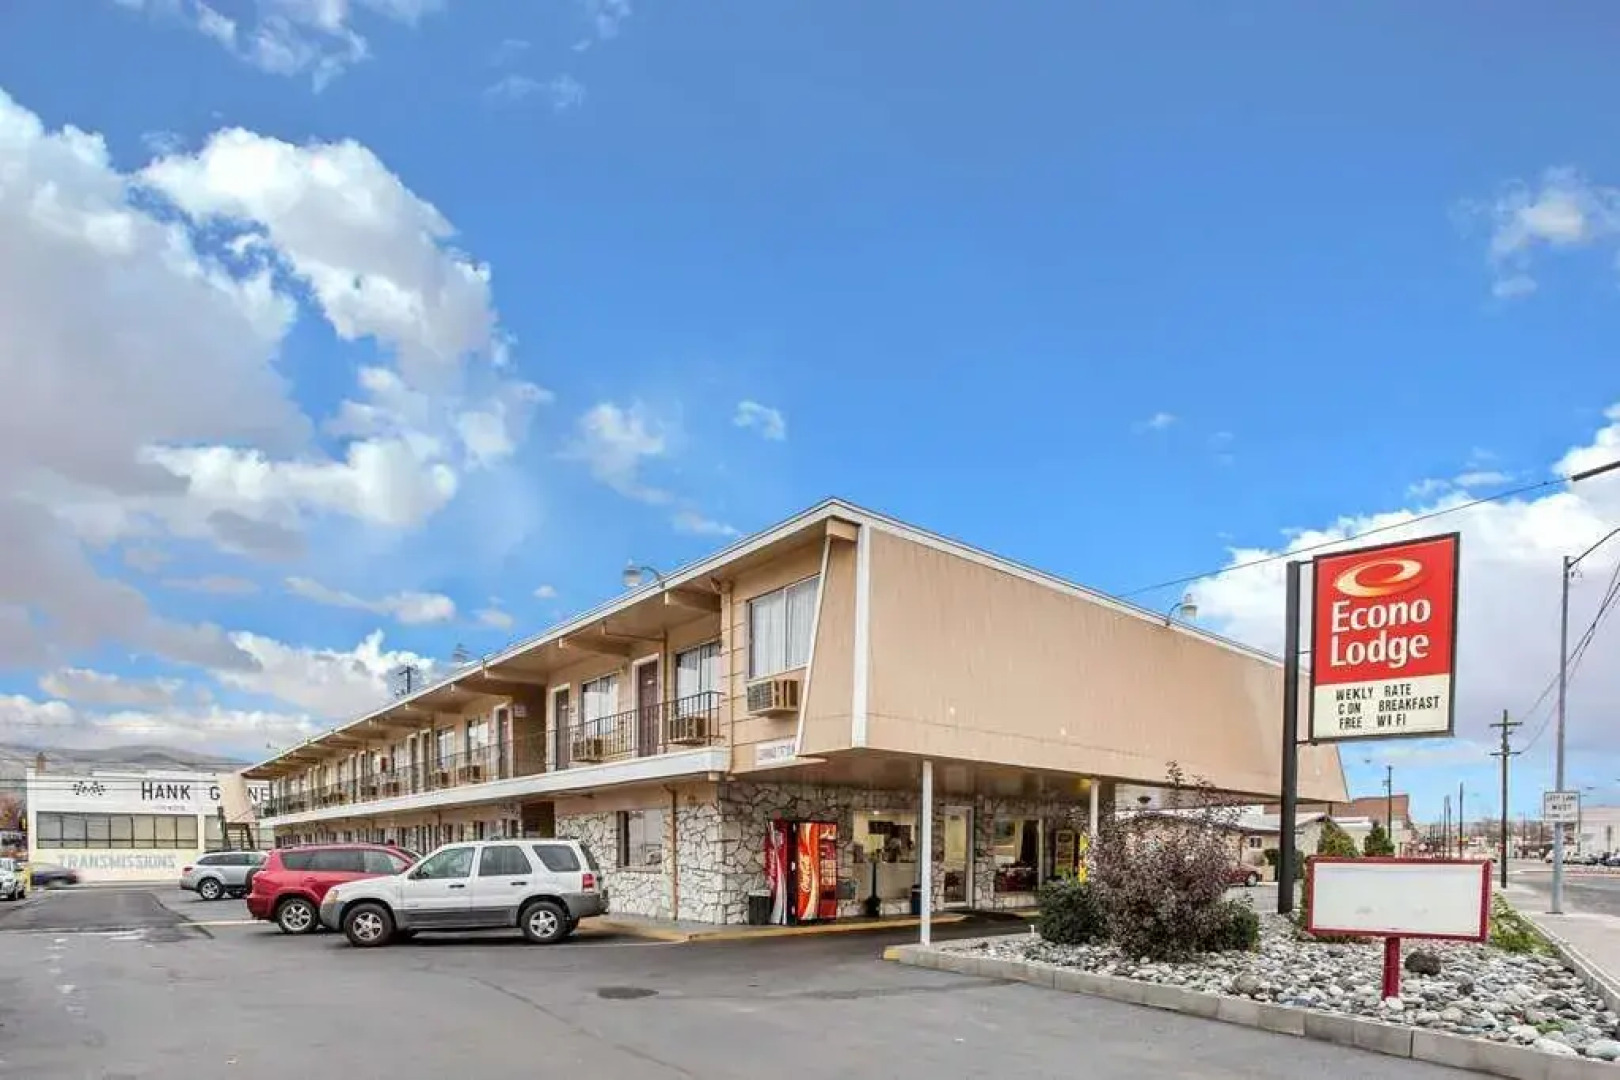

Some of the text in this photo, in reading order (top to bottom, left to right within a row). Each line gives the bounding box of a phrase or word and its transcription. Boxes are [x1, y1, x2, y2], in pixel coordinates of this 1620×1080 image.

[1331, 599, 1431, 633] Econo
[1330, 630, 1429, 669] Lodge
[1336, 684, 1412, 701] WEKLY RATE
[1379, 696, 1440, 712] BREAKFAST
[1340, 716, 1362, 729] FREE
[142, 781, 191, 800] HANK
